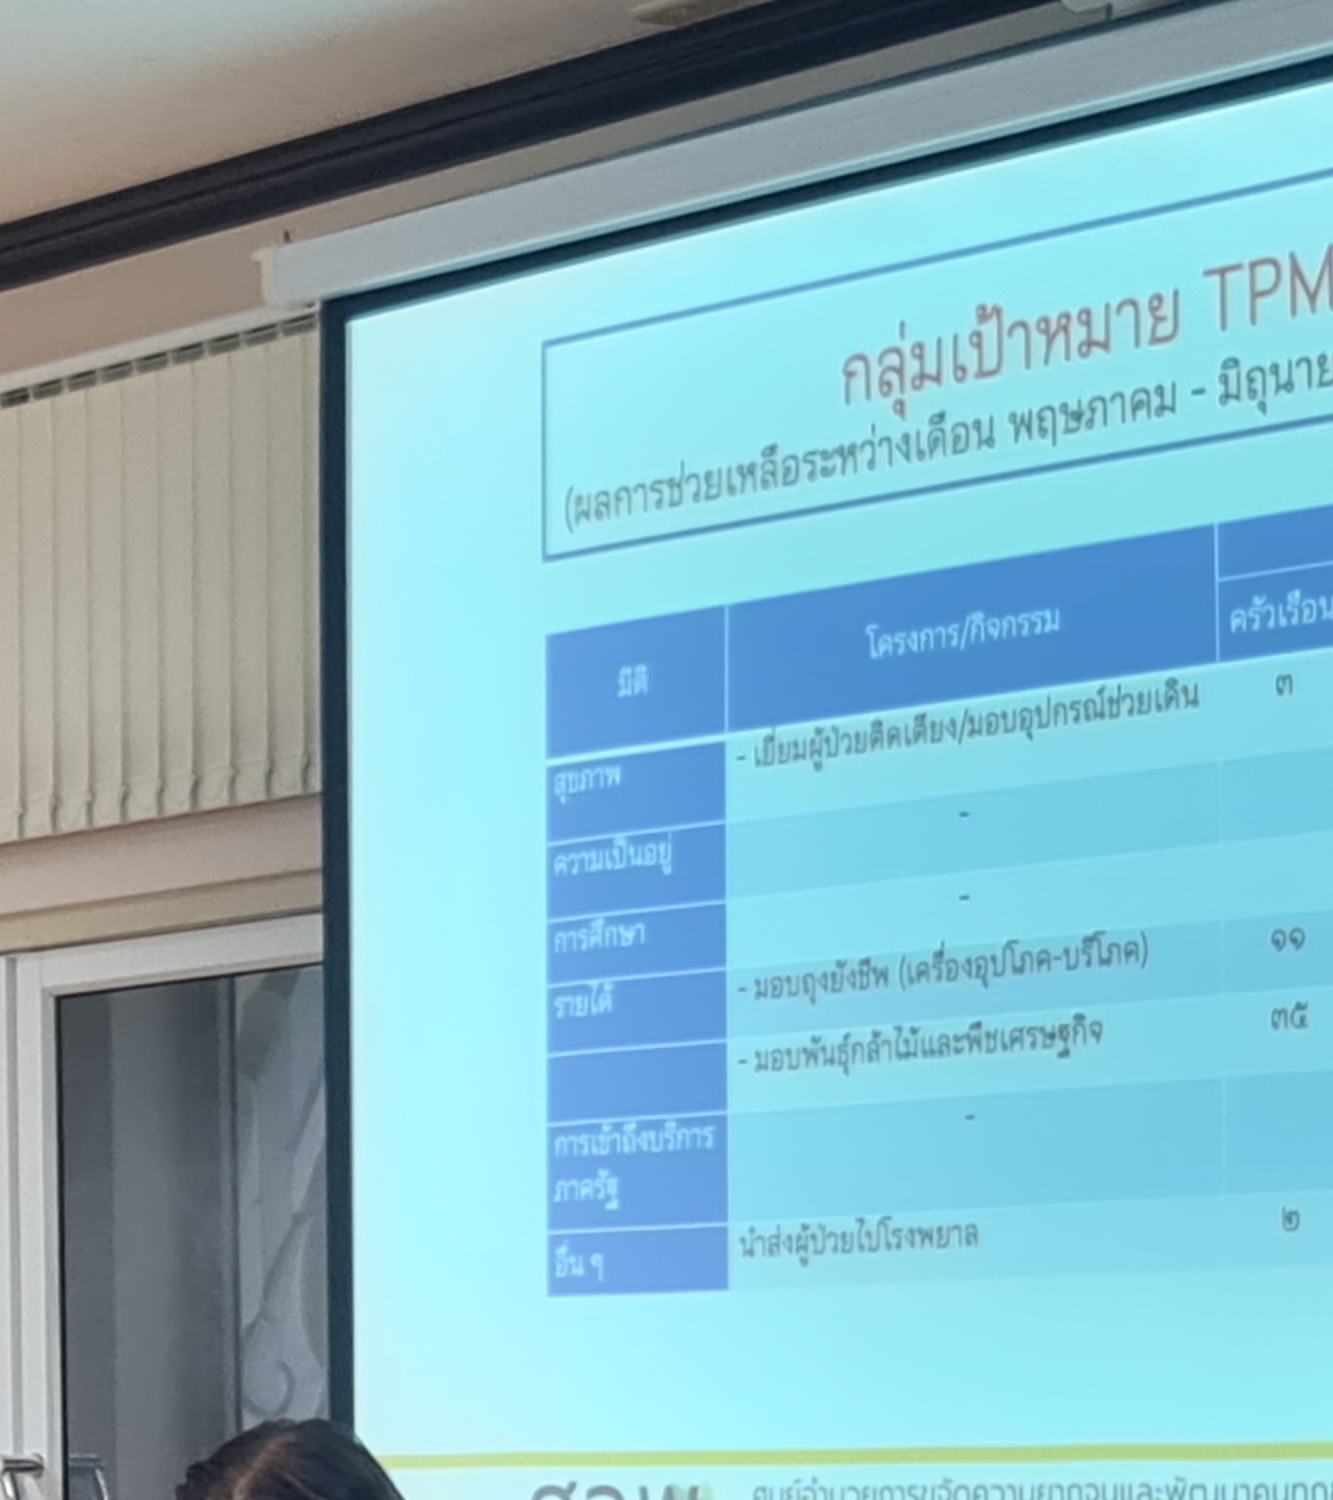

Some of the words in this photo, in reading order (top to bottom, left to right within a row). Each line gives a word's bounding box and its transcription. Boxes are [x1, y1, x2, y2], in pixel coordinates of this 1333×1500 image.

[842, 289, 1180, 419] กลุ่มเป้าหมาย
[565, 410, 996, 533] (ผลการช่วยเหลือระหว่างเดือน
[1009, 380, 1177, 449] พฤษภาคม
[866, 607, 1061, 660] โครงการ/กิจกรรม
[617, 664, 649, 698] มิติ
[1275, 671, 1294, 697] ๓
[554, 764, 622, 805] สุขภาพ
[553, 831, 673, 876] ความเป็นอยู่
[554, 918, 646, 953] การศึกษา
[1270, 926, 1307, 952] ๑๑
[754, 955, 890, 1005] มอบถุงยังชีพ
[898, 930, 1149, 991] (เครื่องอุปโภค-บริโภค)
[553, 980, 613, 1020] รายได้
[754, 1013, 1104, 1076] มอบพันธุ์กล้าไม้และพืชเศรษฐกิจ
[554, 1121, 715, 1157] การเข้าถึงบริการ
[553, 1168, 620, 1210] ภาครัฐ
[1281, 1205, 1301, 1233] ๒
